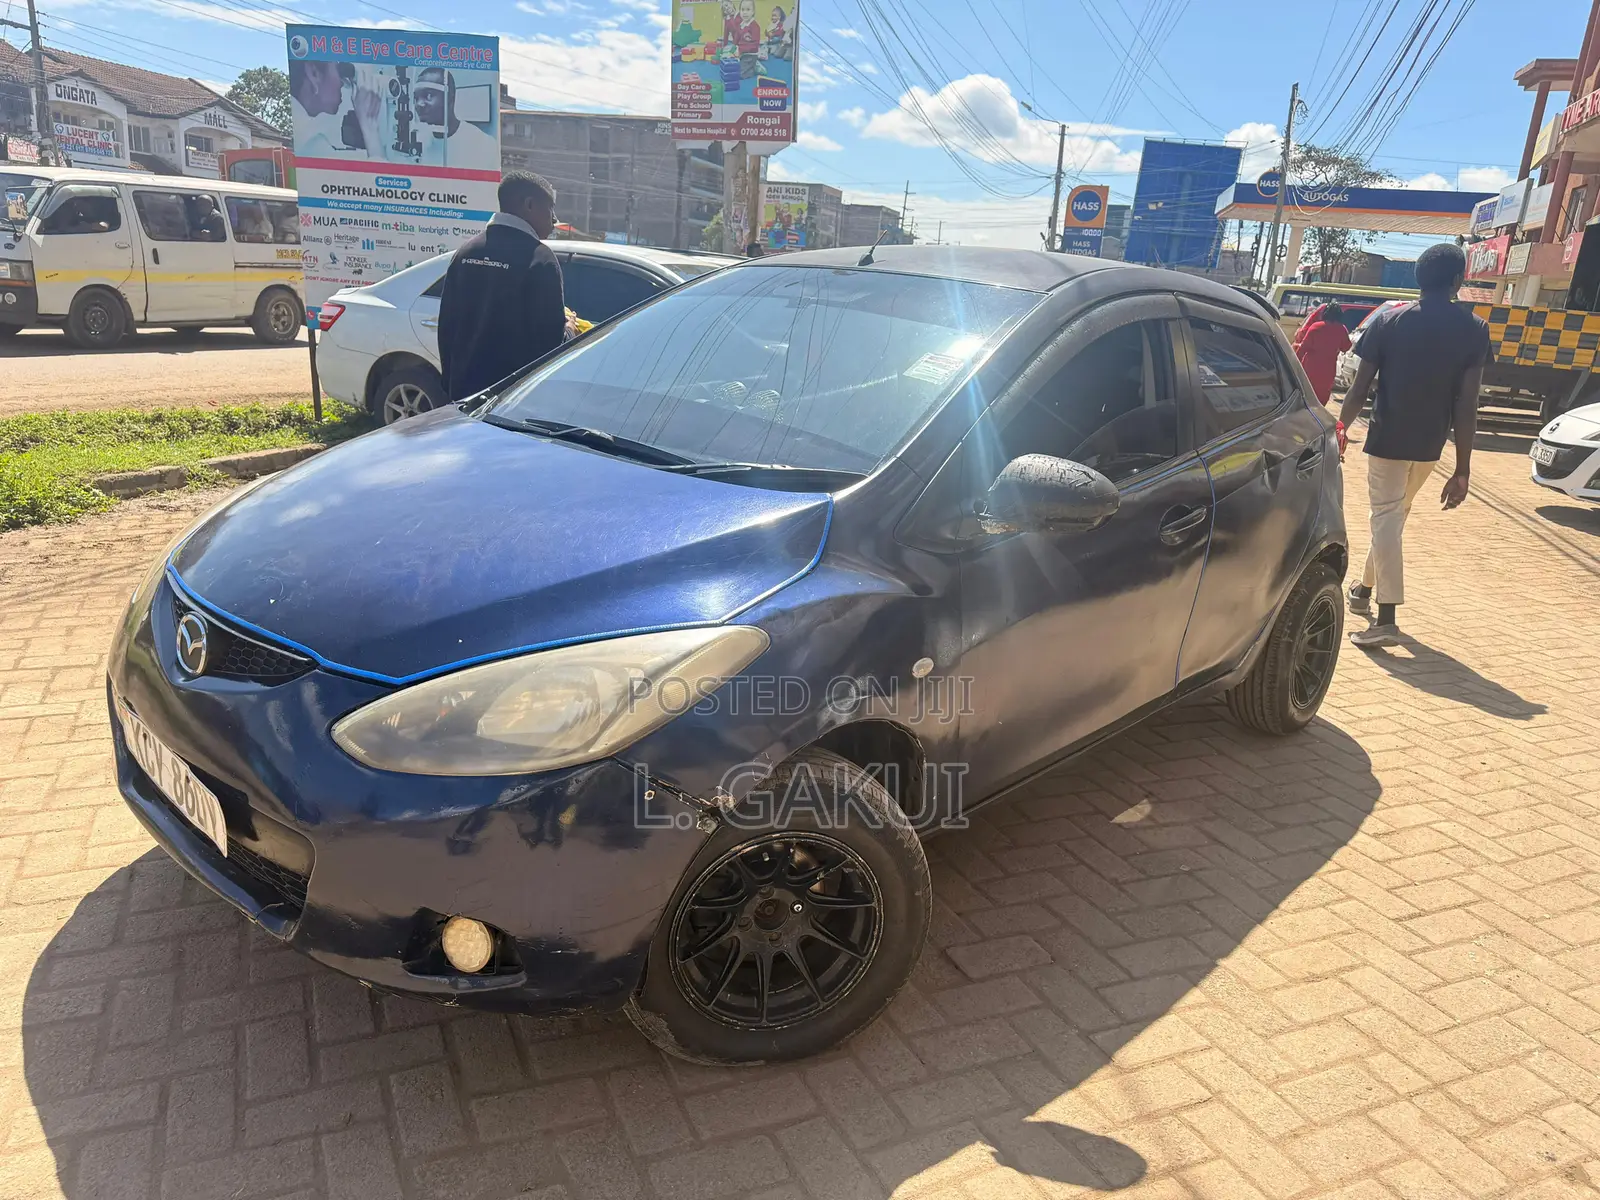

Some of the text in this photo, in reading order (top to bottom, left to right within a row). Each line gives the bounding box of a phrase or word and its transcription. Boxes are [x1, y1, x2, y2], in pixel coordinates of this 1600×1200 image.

[312, 35, 493, 62] M & E Eye Care Centre
[414, 58, 491, 70] Comprehensive Eye Care
[55, 83, 98, 106] ONGATA
[203, 112, 228, 128] MALL
[747, 116, 780, 125] Rongai
[66, 127, 99, 140] LUCENT
[706, 127, 727, 135] Hospital
[759, 128, 773, 136] 248
[88, 140, 112, 150] CLINIC
[377, 177, 408, 187] Services
[1259, 179, 1280, 188] HASS
[321, 184, 468, 204] OPHTHALMOLOGY CLINIC
[785, 187, 806, 195] KIDS
[1303, 191, 1349, 202] AUTOGAS
[327, 200, 464, 218] We accept many INSURANCES Including:
[1073, 201, 1100, 210] HASS
[313, 216, 338, 227] MUA
[348, 219, 379, 228] PACIFIC
[418, 225, 449, 236] kenbright
[302, 235, 323, 243] Allianz
[334, 233, 359, 243] Heritage
[130, 716, 164, 788] KCY
